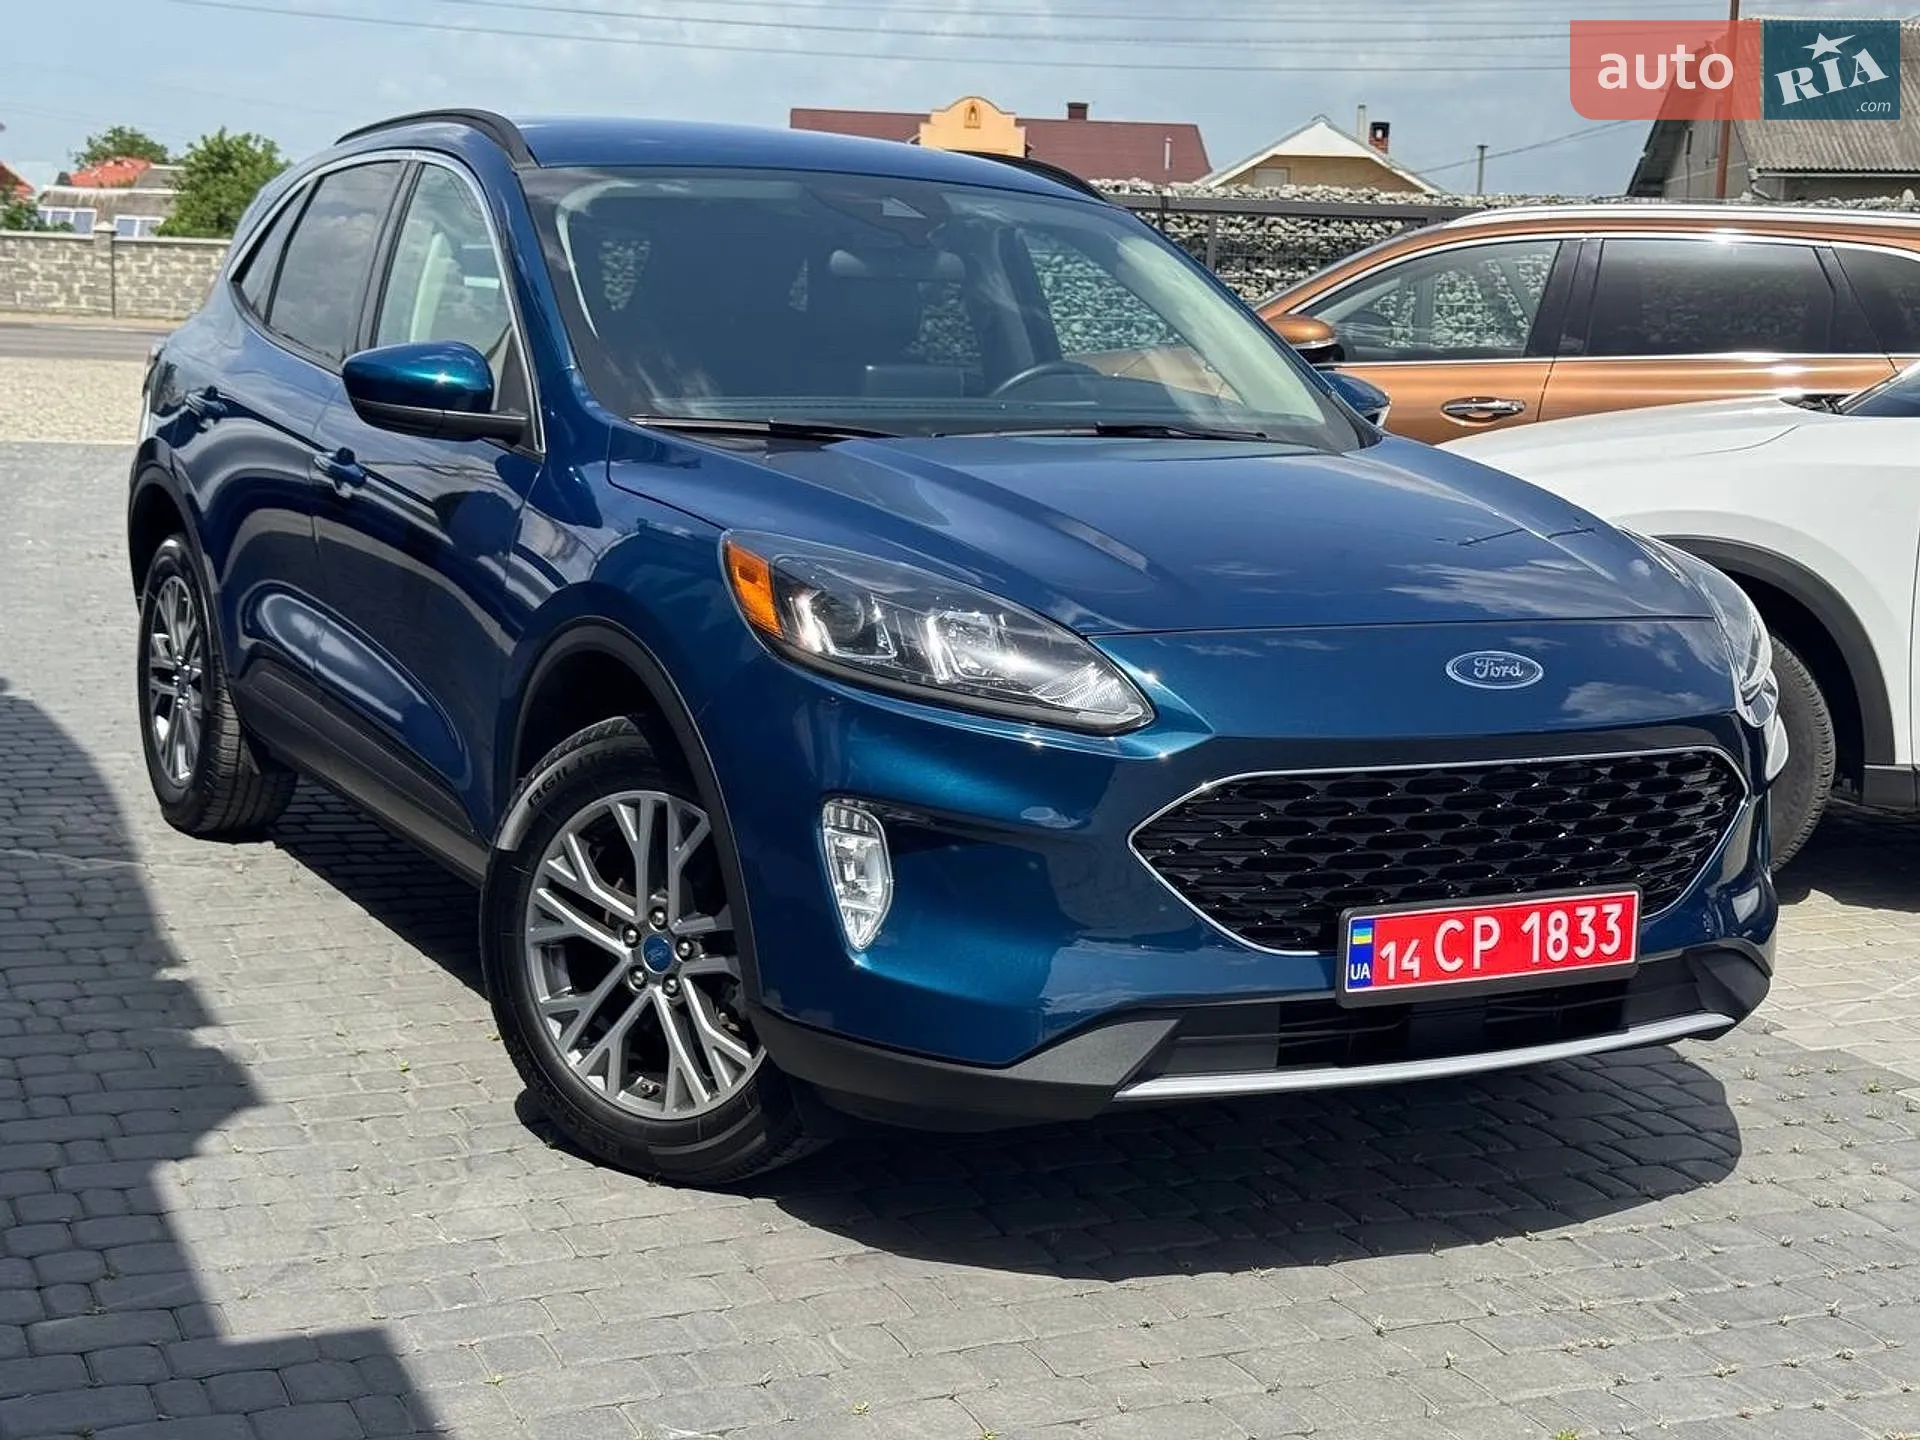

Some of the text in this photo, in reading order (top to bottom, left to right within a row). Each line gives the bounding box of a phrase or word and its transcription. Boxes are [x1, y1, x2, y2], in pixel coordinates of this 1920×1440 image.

[1474, 657, 1524, 679] Ford
[1379, 902, 1623, 981] 14 CP 1833
[1351, 962, 1371, 981] UA
